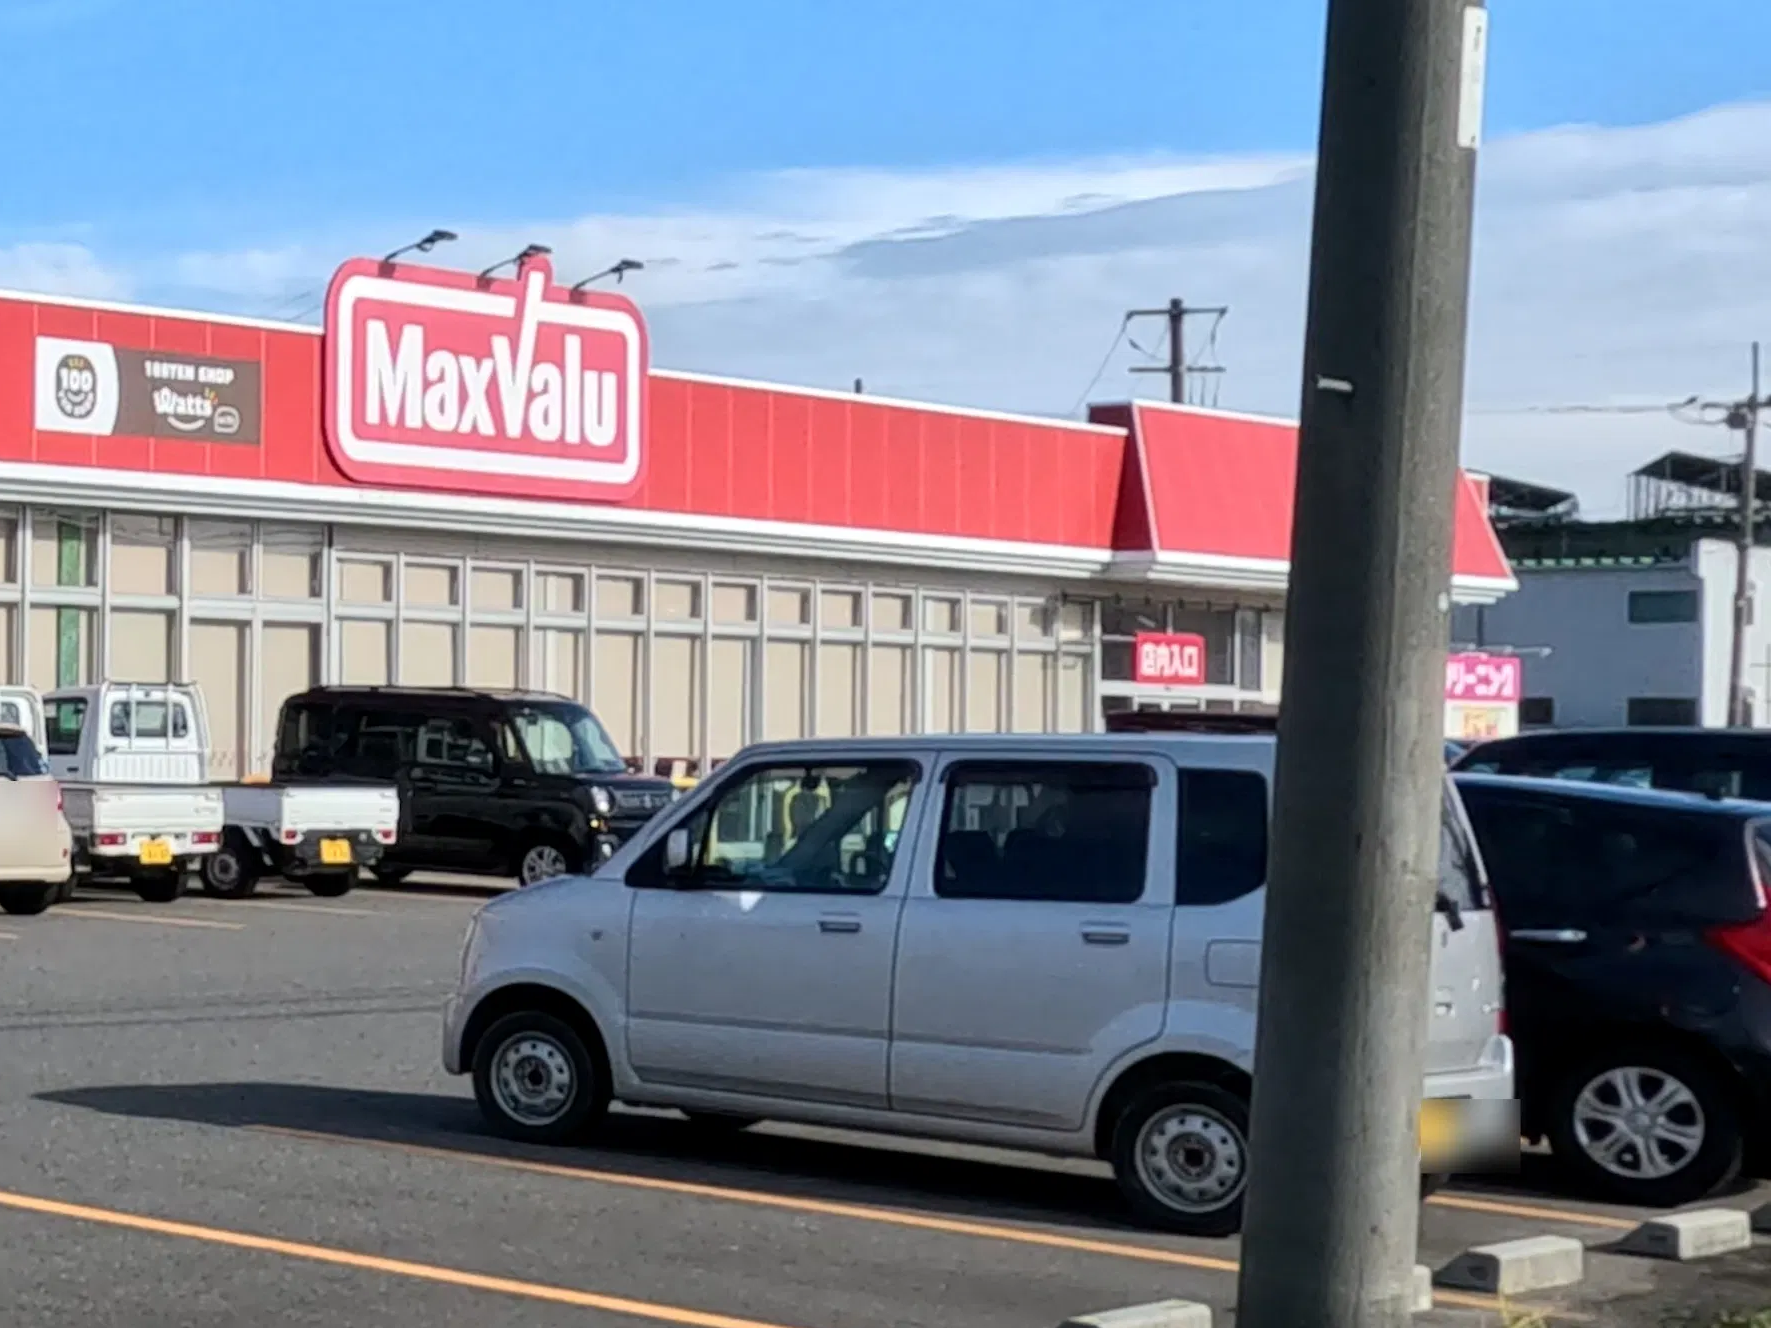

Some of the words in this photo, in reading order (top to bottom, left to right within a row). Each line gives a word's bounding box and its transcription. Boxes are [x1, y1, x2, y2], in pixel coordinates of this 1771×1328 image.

[365, 272, 617, 447] MaxValu
[59, 367, 94, 393] 100
[153, 386, 213, 418] Watts
